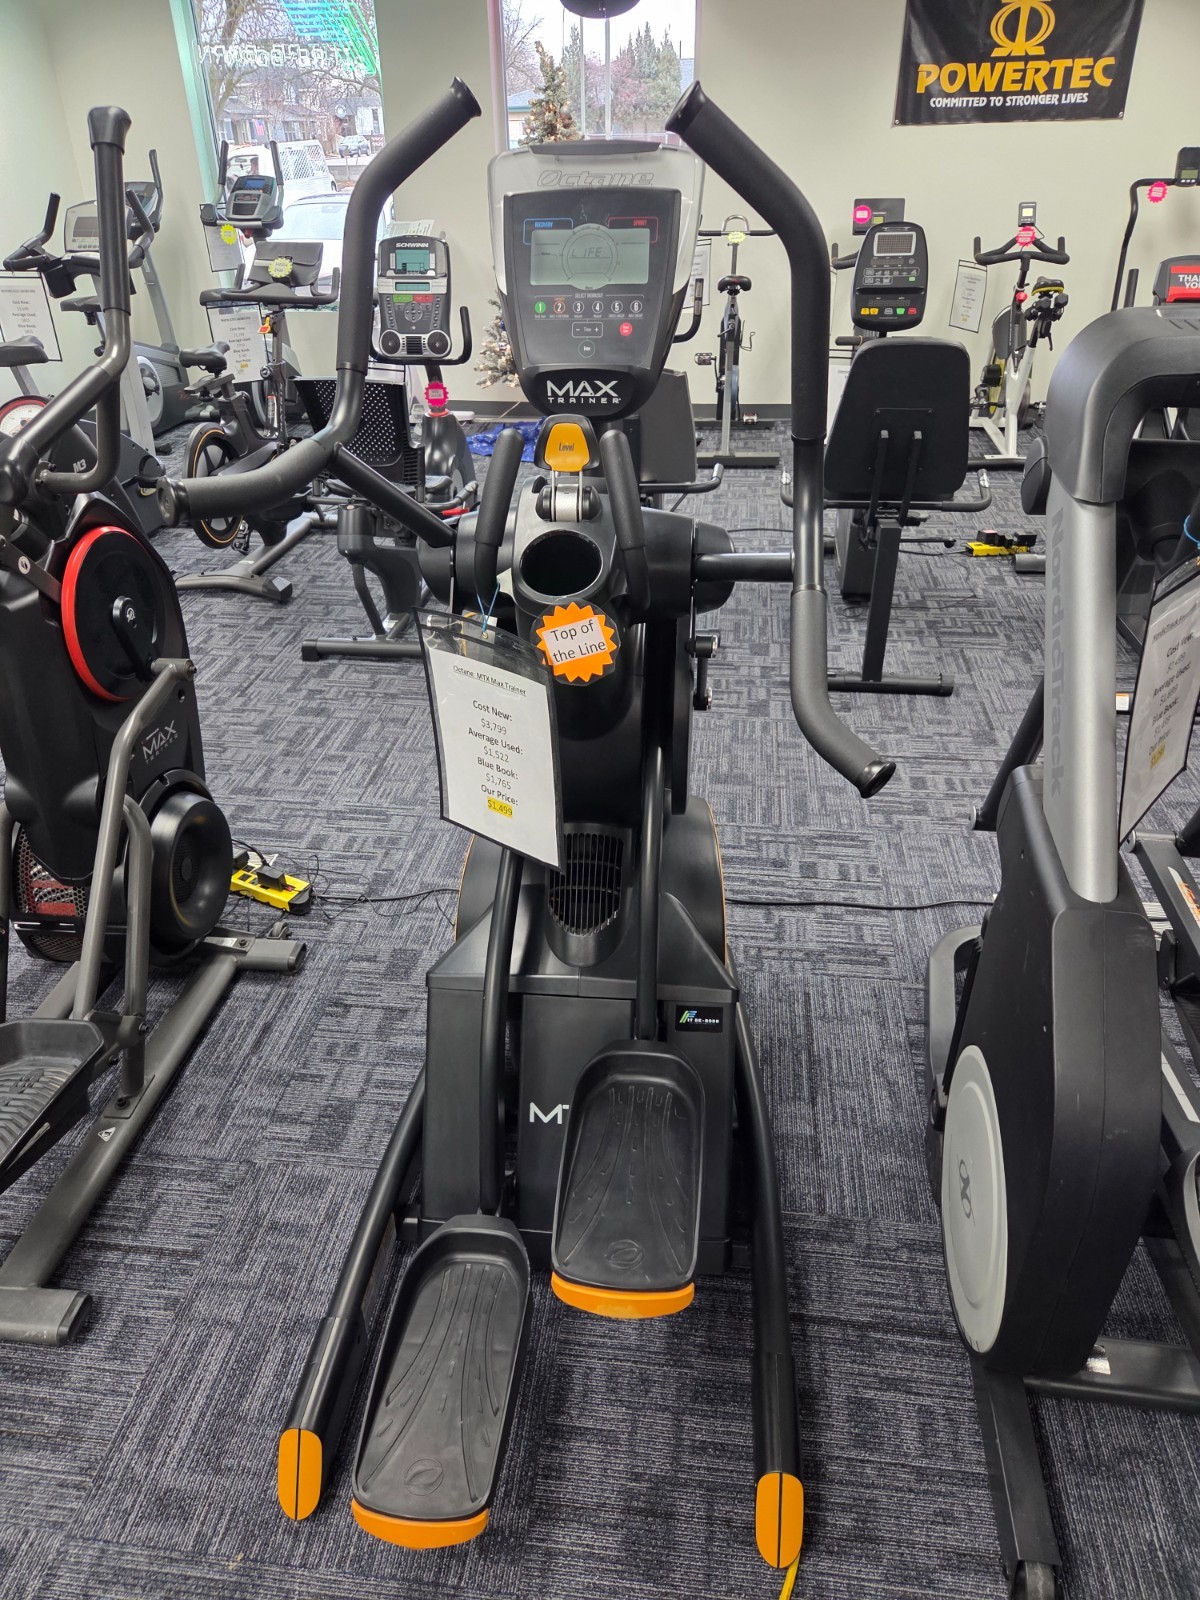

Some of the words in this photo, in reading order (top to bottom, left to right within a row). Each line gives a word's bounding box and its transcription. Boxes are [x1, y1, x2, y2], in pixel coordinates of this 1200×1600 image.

[916, 57, 1116, 94] POWERTEC
[930, 97, 987, 108] COMMITTED
[989, 96, 1003, 107] TO
[1005, 94, 1059, 107] STRONGER
[1061, 93, 1089, 105] LIVES
[537, 170, 655, 187] Octane
[547, 380, 618, 397] MAX
[559, 442, 574, 451] Level
[73, 459, 87, 473] M3
[550, 629, 578, 642] Top
[582, 619, 594, 635] of
[553, 650, 576, 664] the
[578, 640, 607, 657] Line
[1050, 507, 1065, 797] NordicTrack
[453, 665, 474, 677] Octane
[476, 672, 490, 682] MTX
[491, 678, 504, 687] Max
[505, 682, 526, 696] Trainer
[473, 700, 490, 713] Cost
[492, 706, 513, 721] New:
[481, 718, 507, 735] $3,799
[142, 720, 177, 760] MAX
[468, 727, 499, 746] Average
[501, 739, 523, 755] Used:
[484, 745, 509, 763] $1,522
[477, 757, 494, 770] Blue
[496, 764, 518, 780] Book:
[485, 772, 512, 790] $1,765
[481, 784, 495, 796] Our
[497, 790, 518, 806] Price:
[487, 799, 513, 816] $1,499
